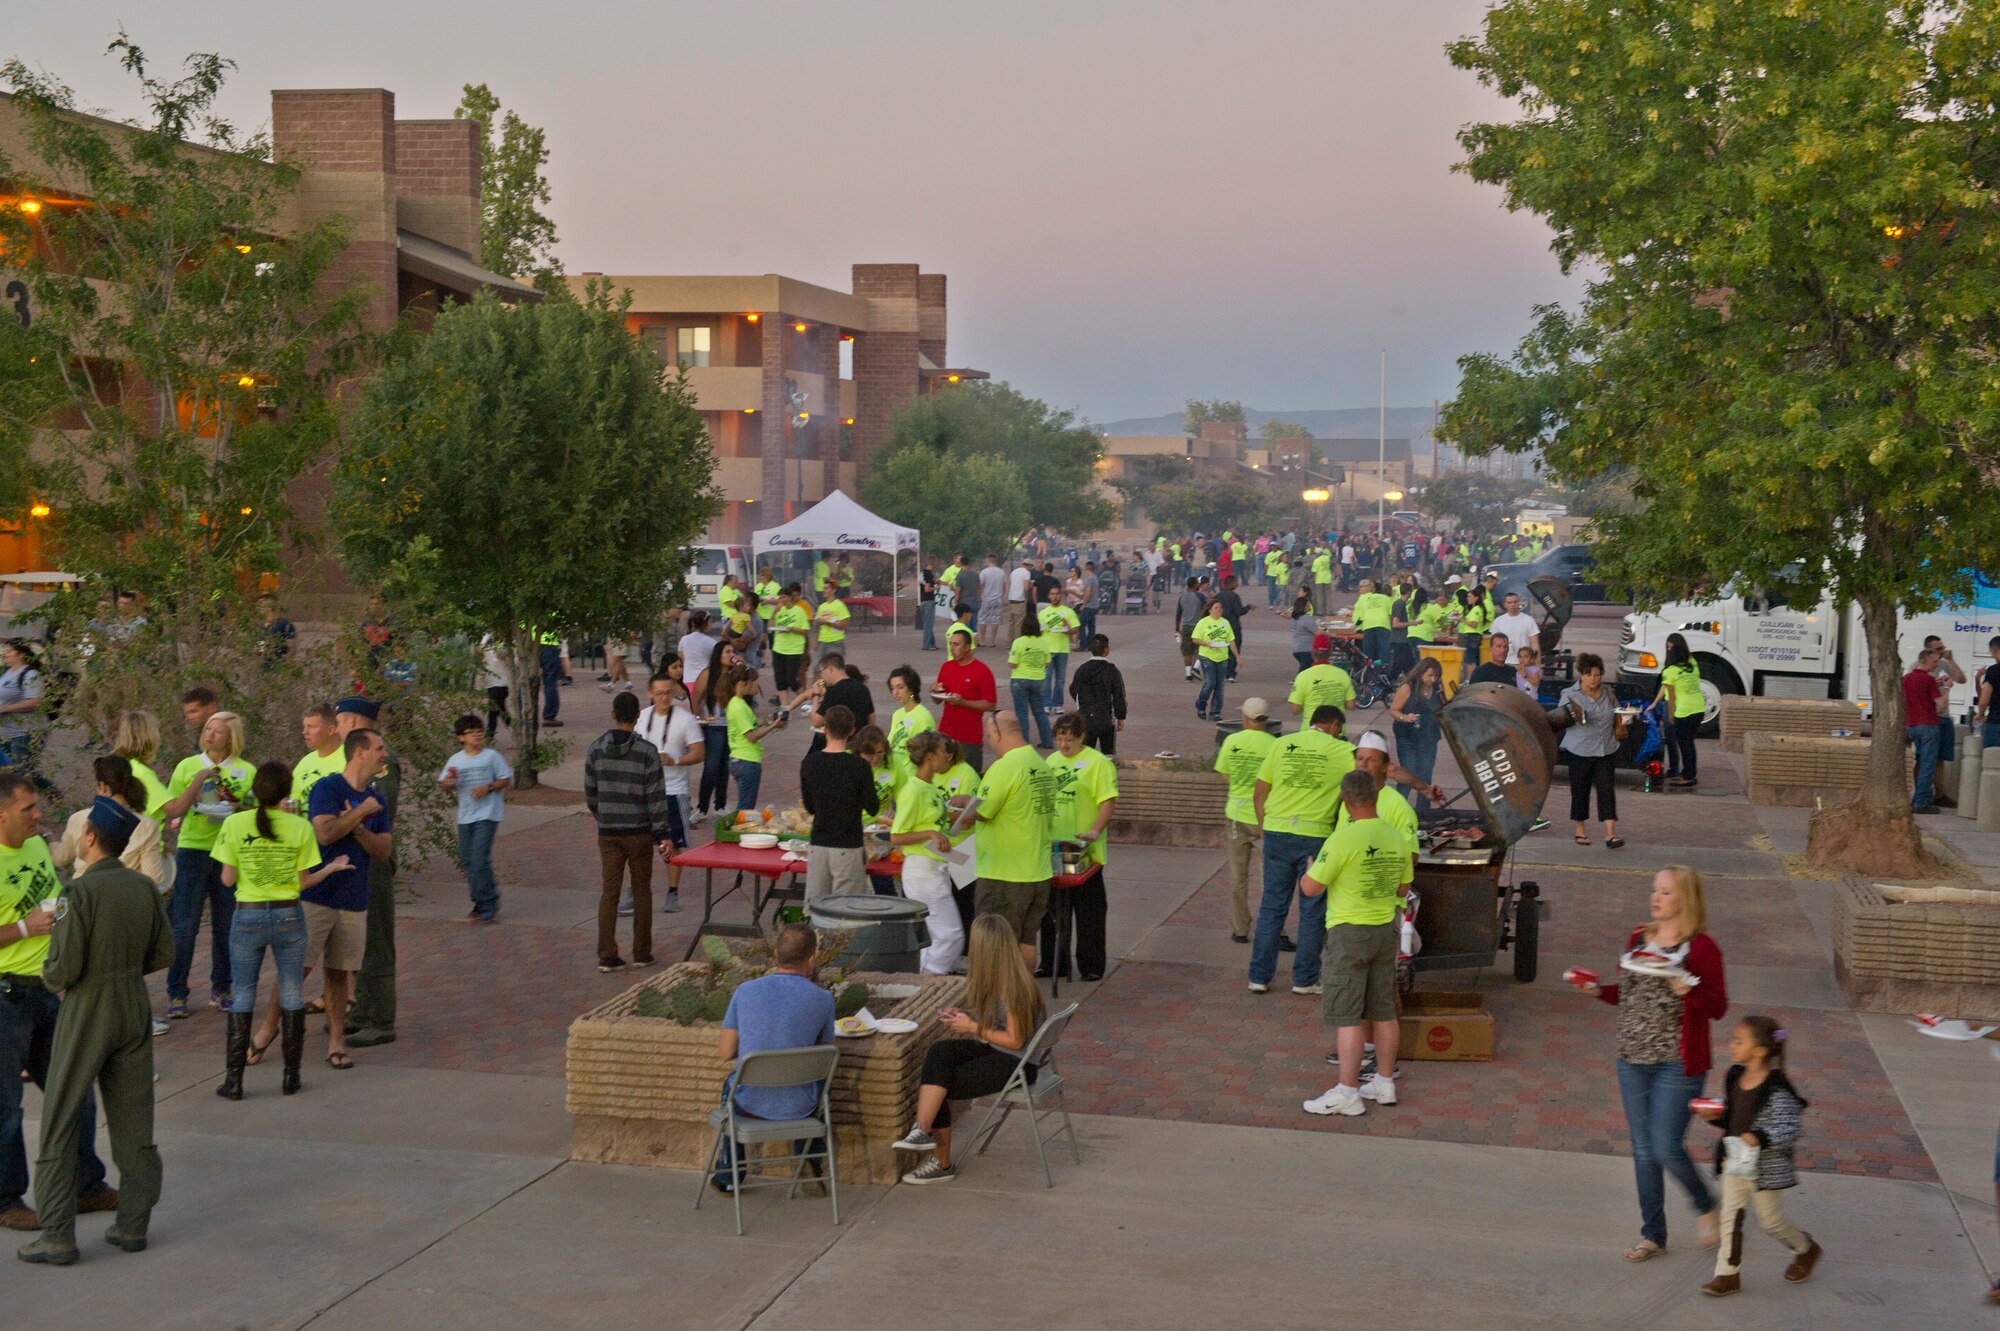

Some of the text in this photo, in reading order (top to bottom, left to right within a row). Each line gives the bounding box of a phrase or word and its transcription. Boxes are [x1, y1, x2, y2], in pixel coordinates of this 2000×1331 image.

[769, 534, 809, 546] Country
[836, 533, 876, 546] Country
[1954, 621, 1994, 633] better
[1491, 749, 1517, 785] ODR
[1474, 759, 1500, 793] BBQ
